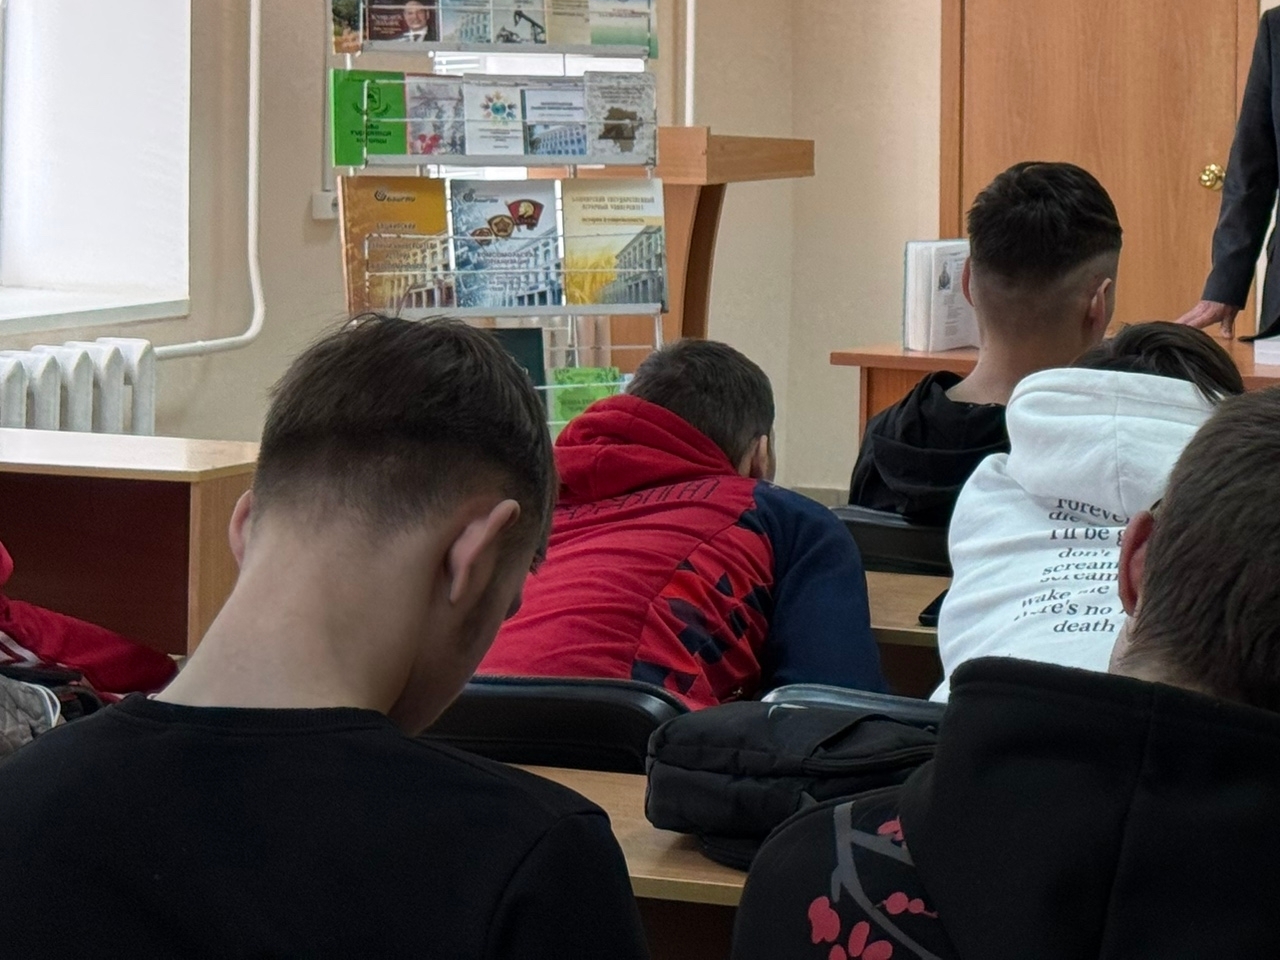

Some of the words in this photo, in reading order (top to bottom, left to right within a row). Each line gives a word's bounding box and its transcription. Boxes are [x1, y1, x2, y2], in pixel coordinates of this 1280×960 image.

[1049, 527, 1078, 541] Ill
[1084, 527, 1110, 541] be
[1083, 604, 1113, 616] no
[1053, 618, 1116, 633] death
